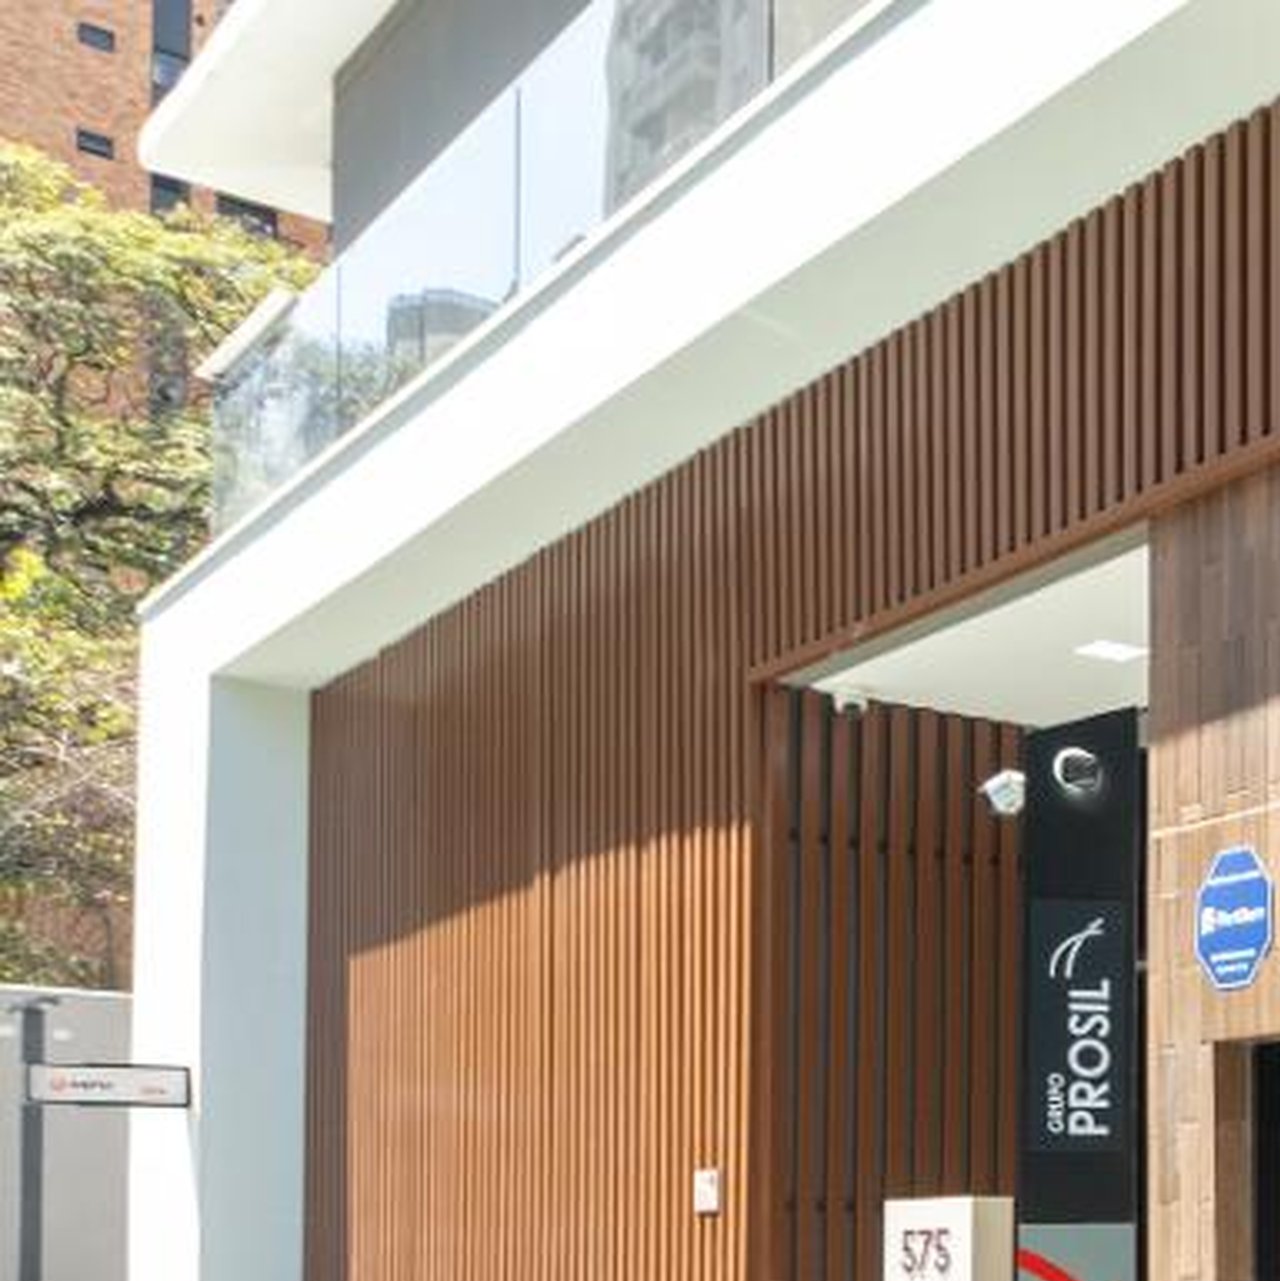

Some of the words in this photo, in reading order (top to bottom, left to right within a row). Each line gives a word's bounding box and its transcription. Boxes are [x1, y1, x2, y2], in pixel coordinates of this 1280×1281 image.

[1067, 978, 1111, 1136] PROSIL
[1046, 1072, 1065, 1134] GRUPO
[901, 1228, 952, 1276] 575
